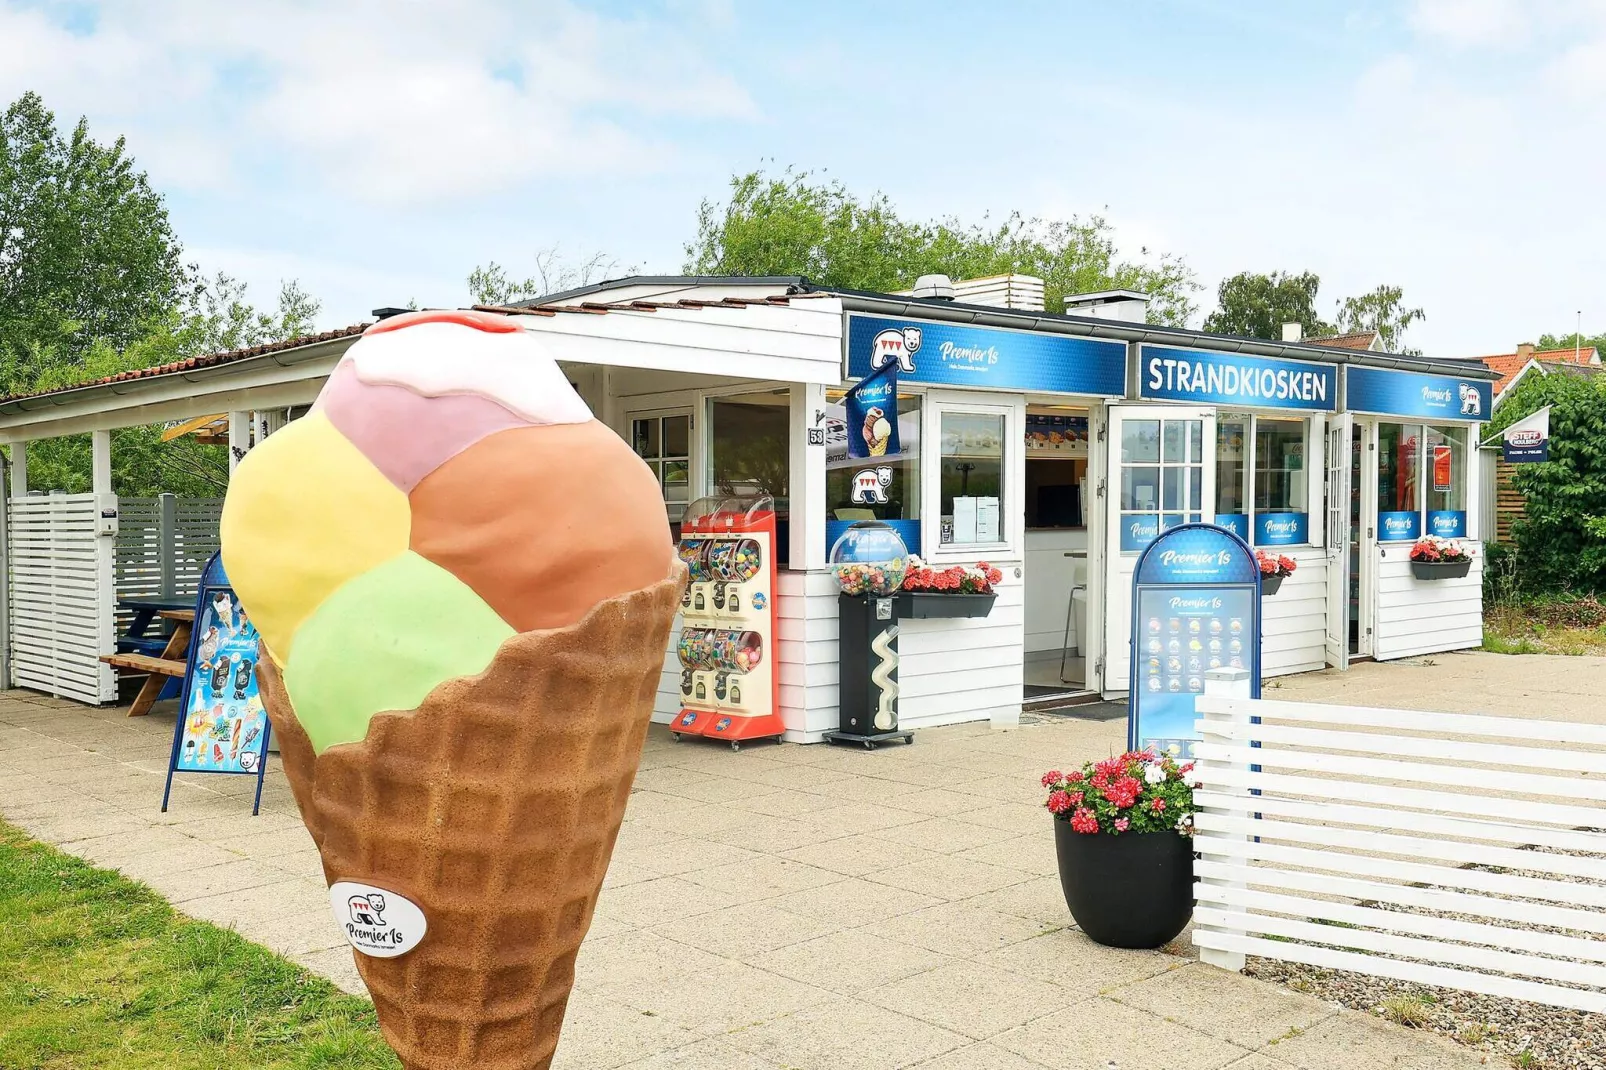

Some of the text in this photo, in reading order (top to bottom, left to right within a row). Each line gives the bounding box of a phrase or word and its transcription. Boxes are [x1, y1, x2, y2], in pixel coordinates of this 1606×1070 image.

[939, 341, 986, 363] Premier
[1149, 357, 1327, 402] STRANDKIOSKEN
[1422, 386, 1445, 401] Premier
[810, 431, 824, 444] 53
[1513, 432, 1540, 440] STEFF
[1265, 520, 1291, 534] Premier
[1385, 517, 1406, 530] Premier
[1433, 516, 1453, 528] Premier
[1160, 549, 1216, 566] Premier
[1169, 596, 1211, 609] Premier
[346, 923, 403, 944] Premier Is
